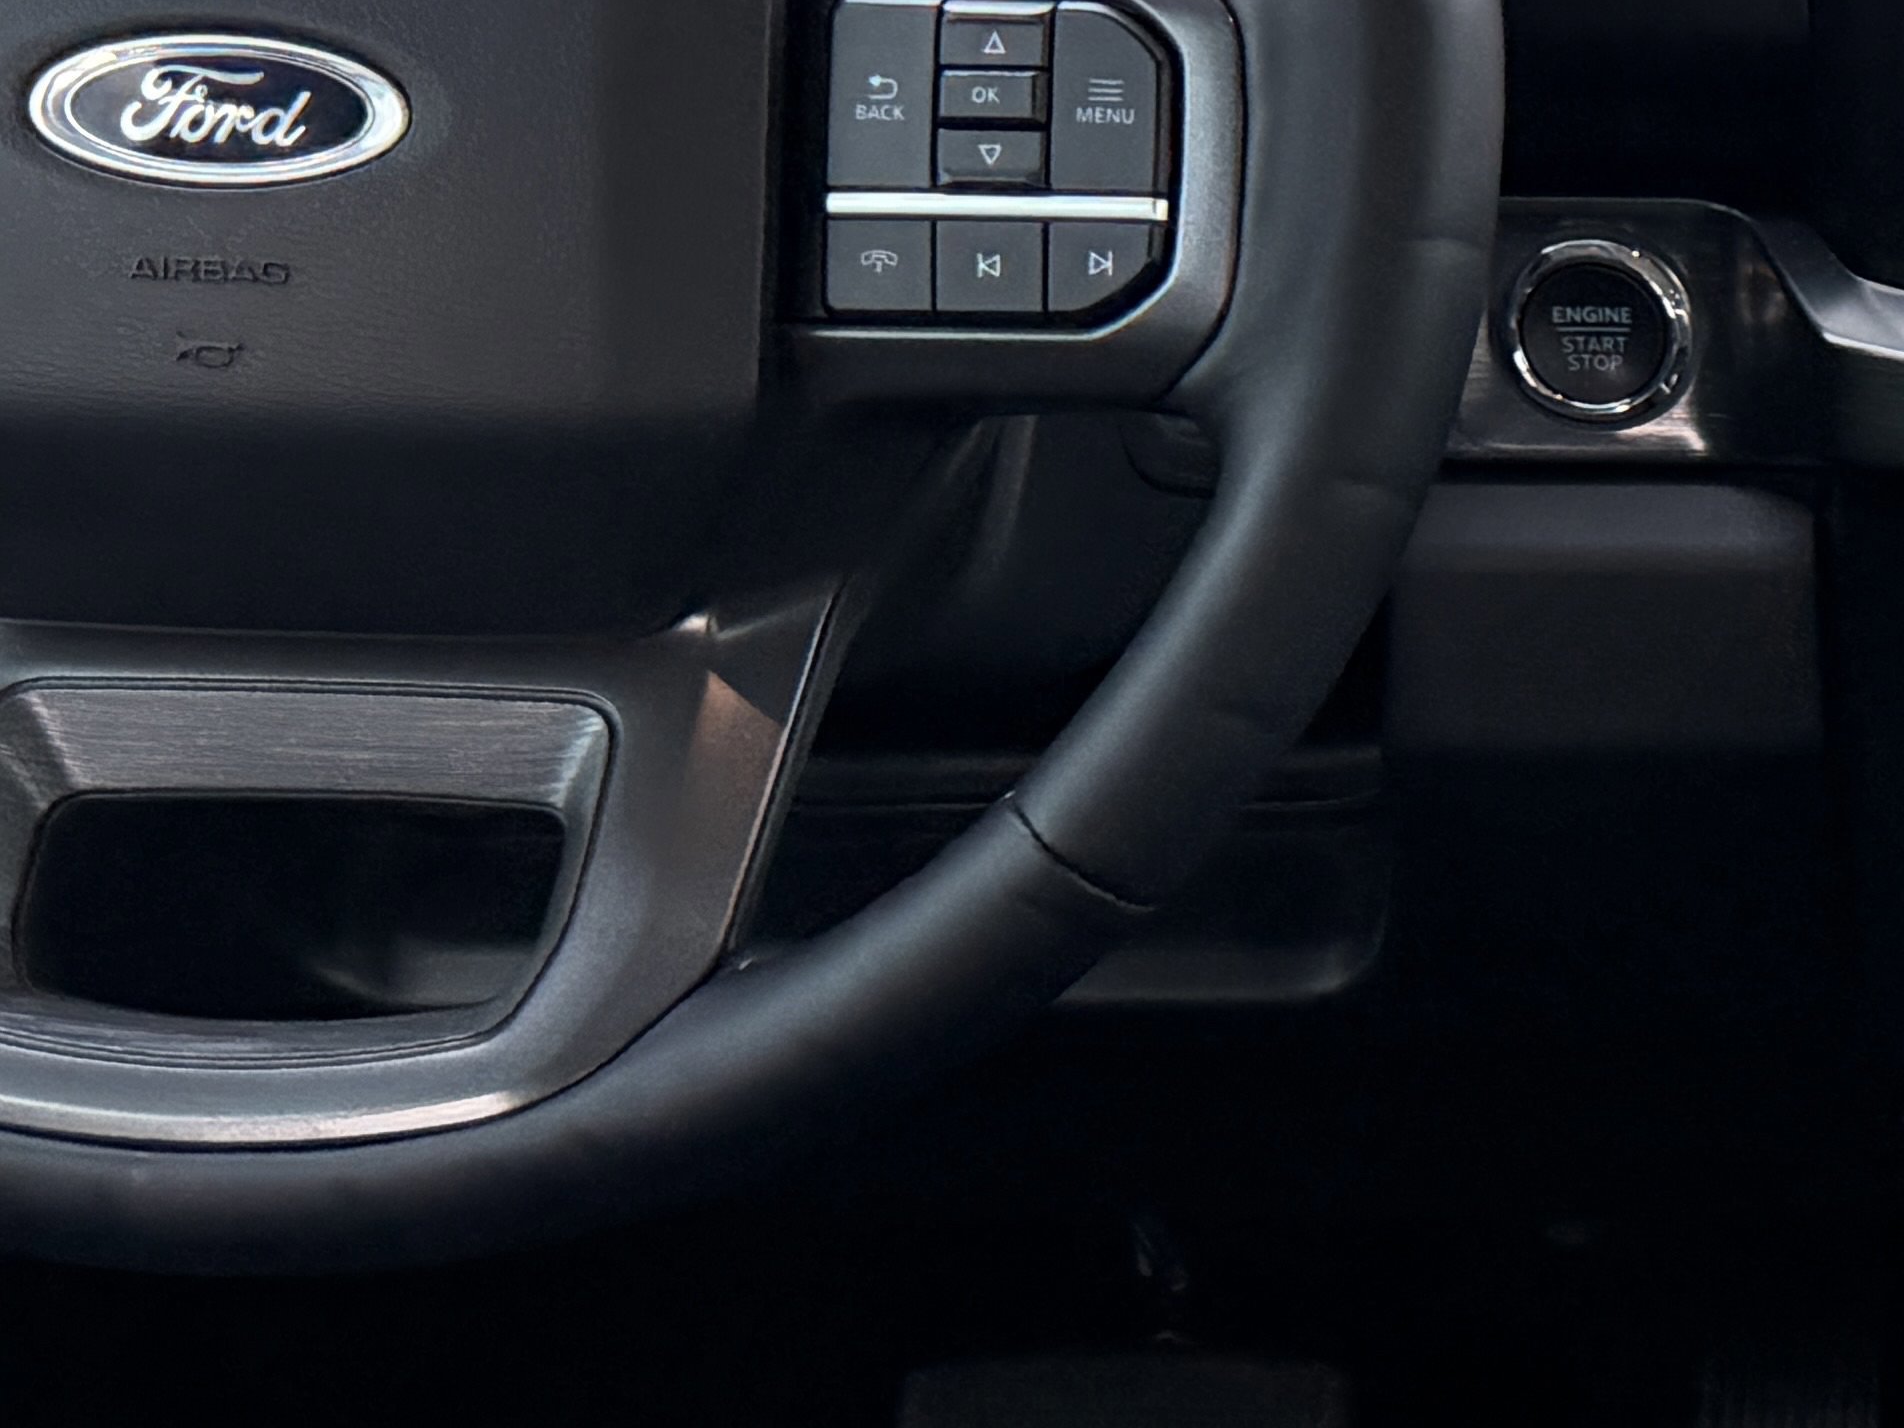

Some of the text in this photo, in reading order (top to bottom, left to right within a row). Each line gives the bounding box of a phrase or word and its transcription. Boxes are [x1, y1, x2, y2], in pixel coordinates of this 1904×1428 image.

[971, 84, 1001, 104] OK
[117, 65, 308, 151] Ford
[855, 101, 905, 123] BACK
[1076, 104, 1136, 126] MENU
[128, 251, 293, 286] AIRBAG
[1551, 304, 1633, 325] ENGINE
[1560, 334, 1628, 354] START
[1567, 353, 1623, 373] STOP
